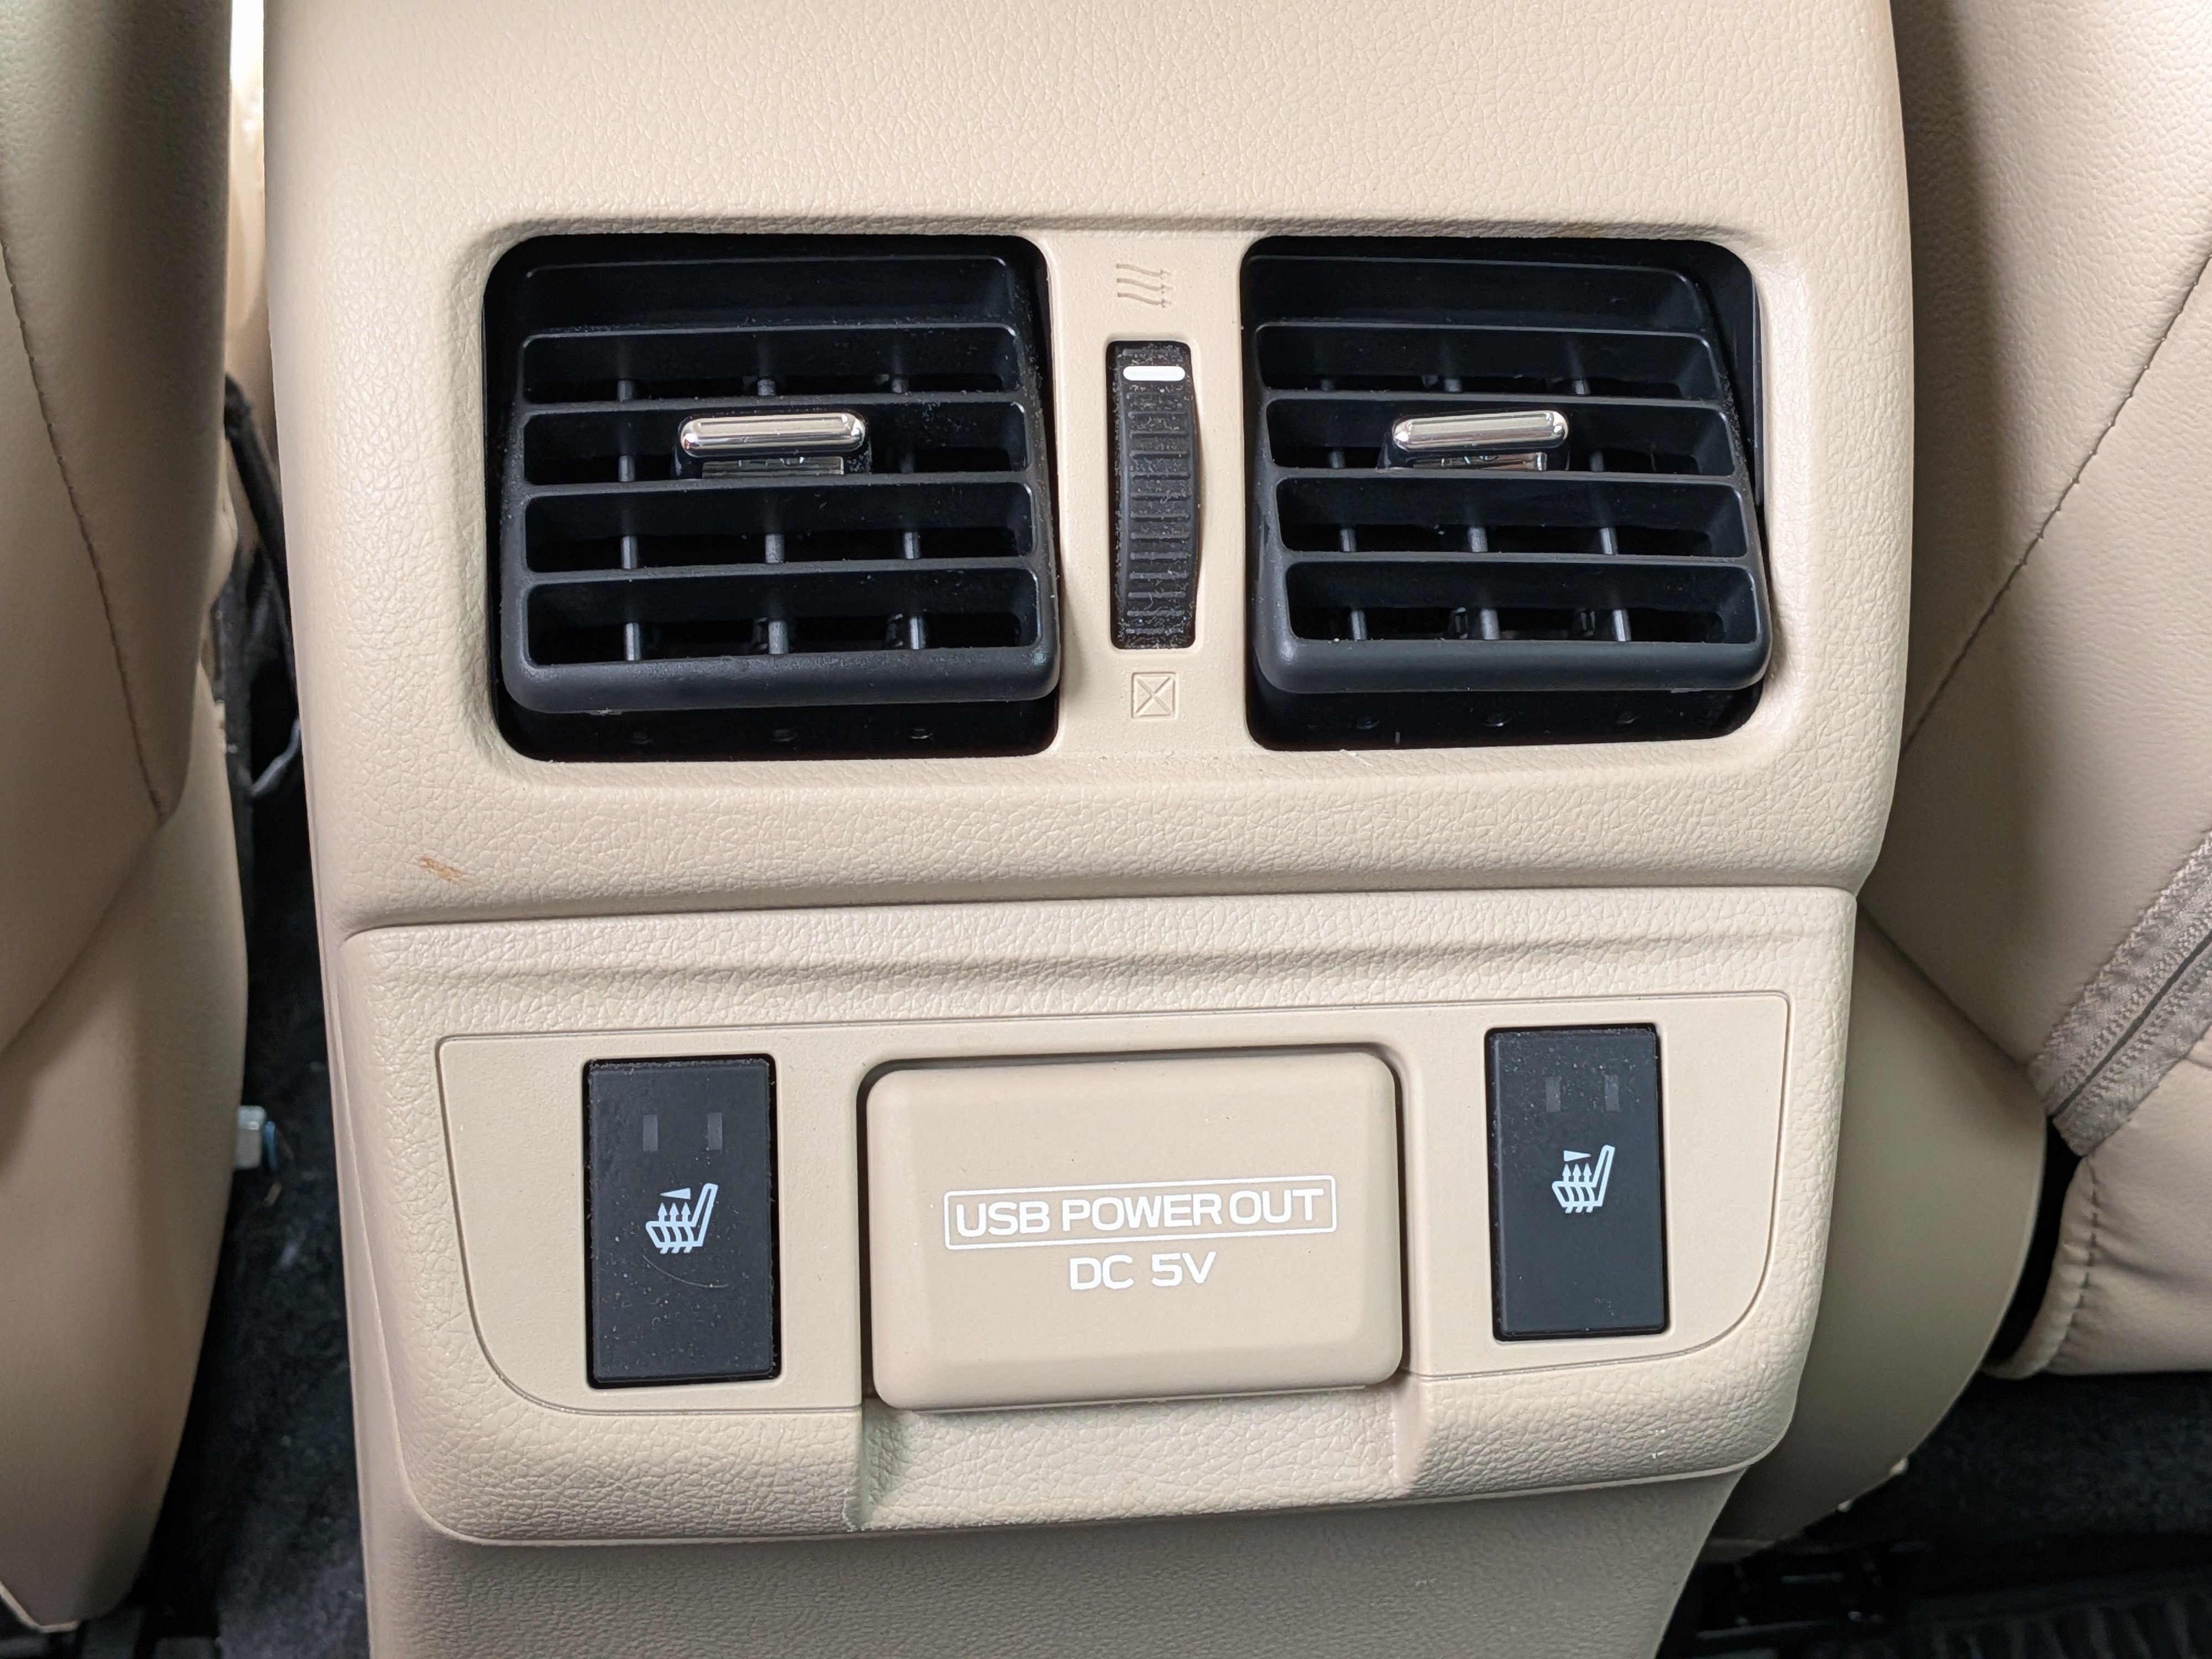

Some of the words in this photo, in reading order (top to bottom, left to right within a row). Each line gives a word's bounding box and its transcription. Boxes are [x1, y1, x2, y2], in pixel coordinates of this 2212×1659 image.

[956, 1201, 1050, 1237] USB
[1062, 1193, 1223, 1232] POWER
[1229, 1188, 1324, 1224] OUT
[1070, 1255, 1134, 1290] DC
[1151, 1251, 1216, 1287] 5V
